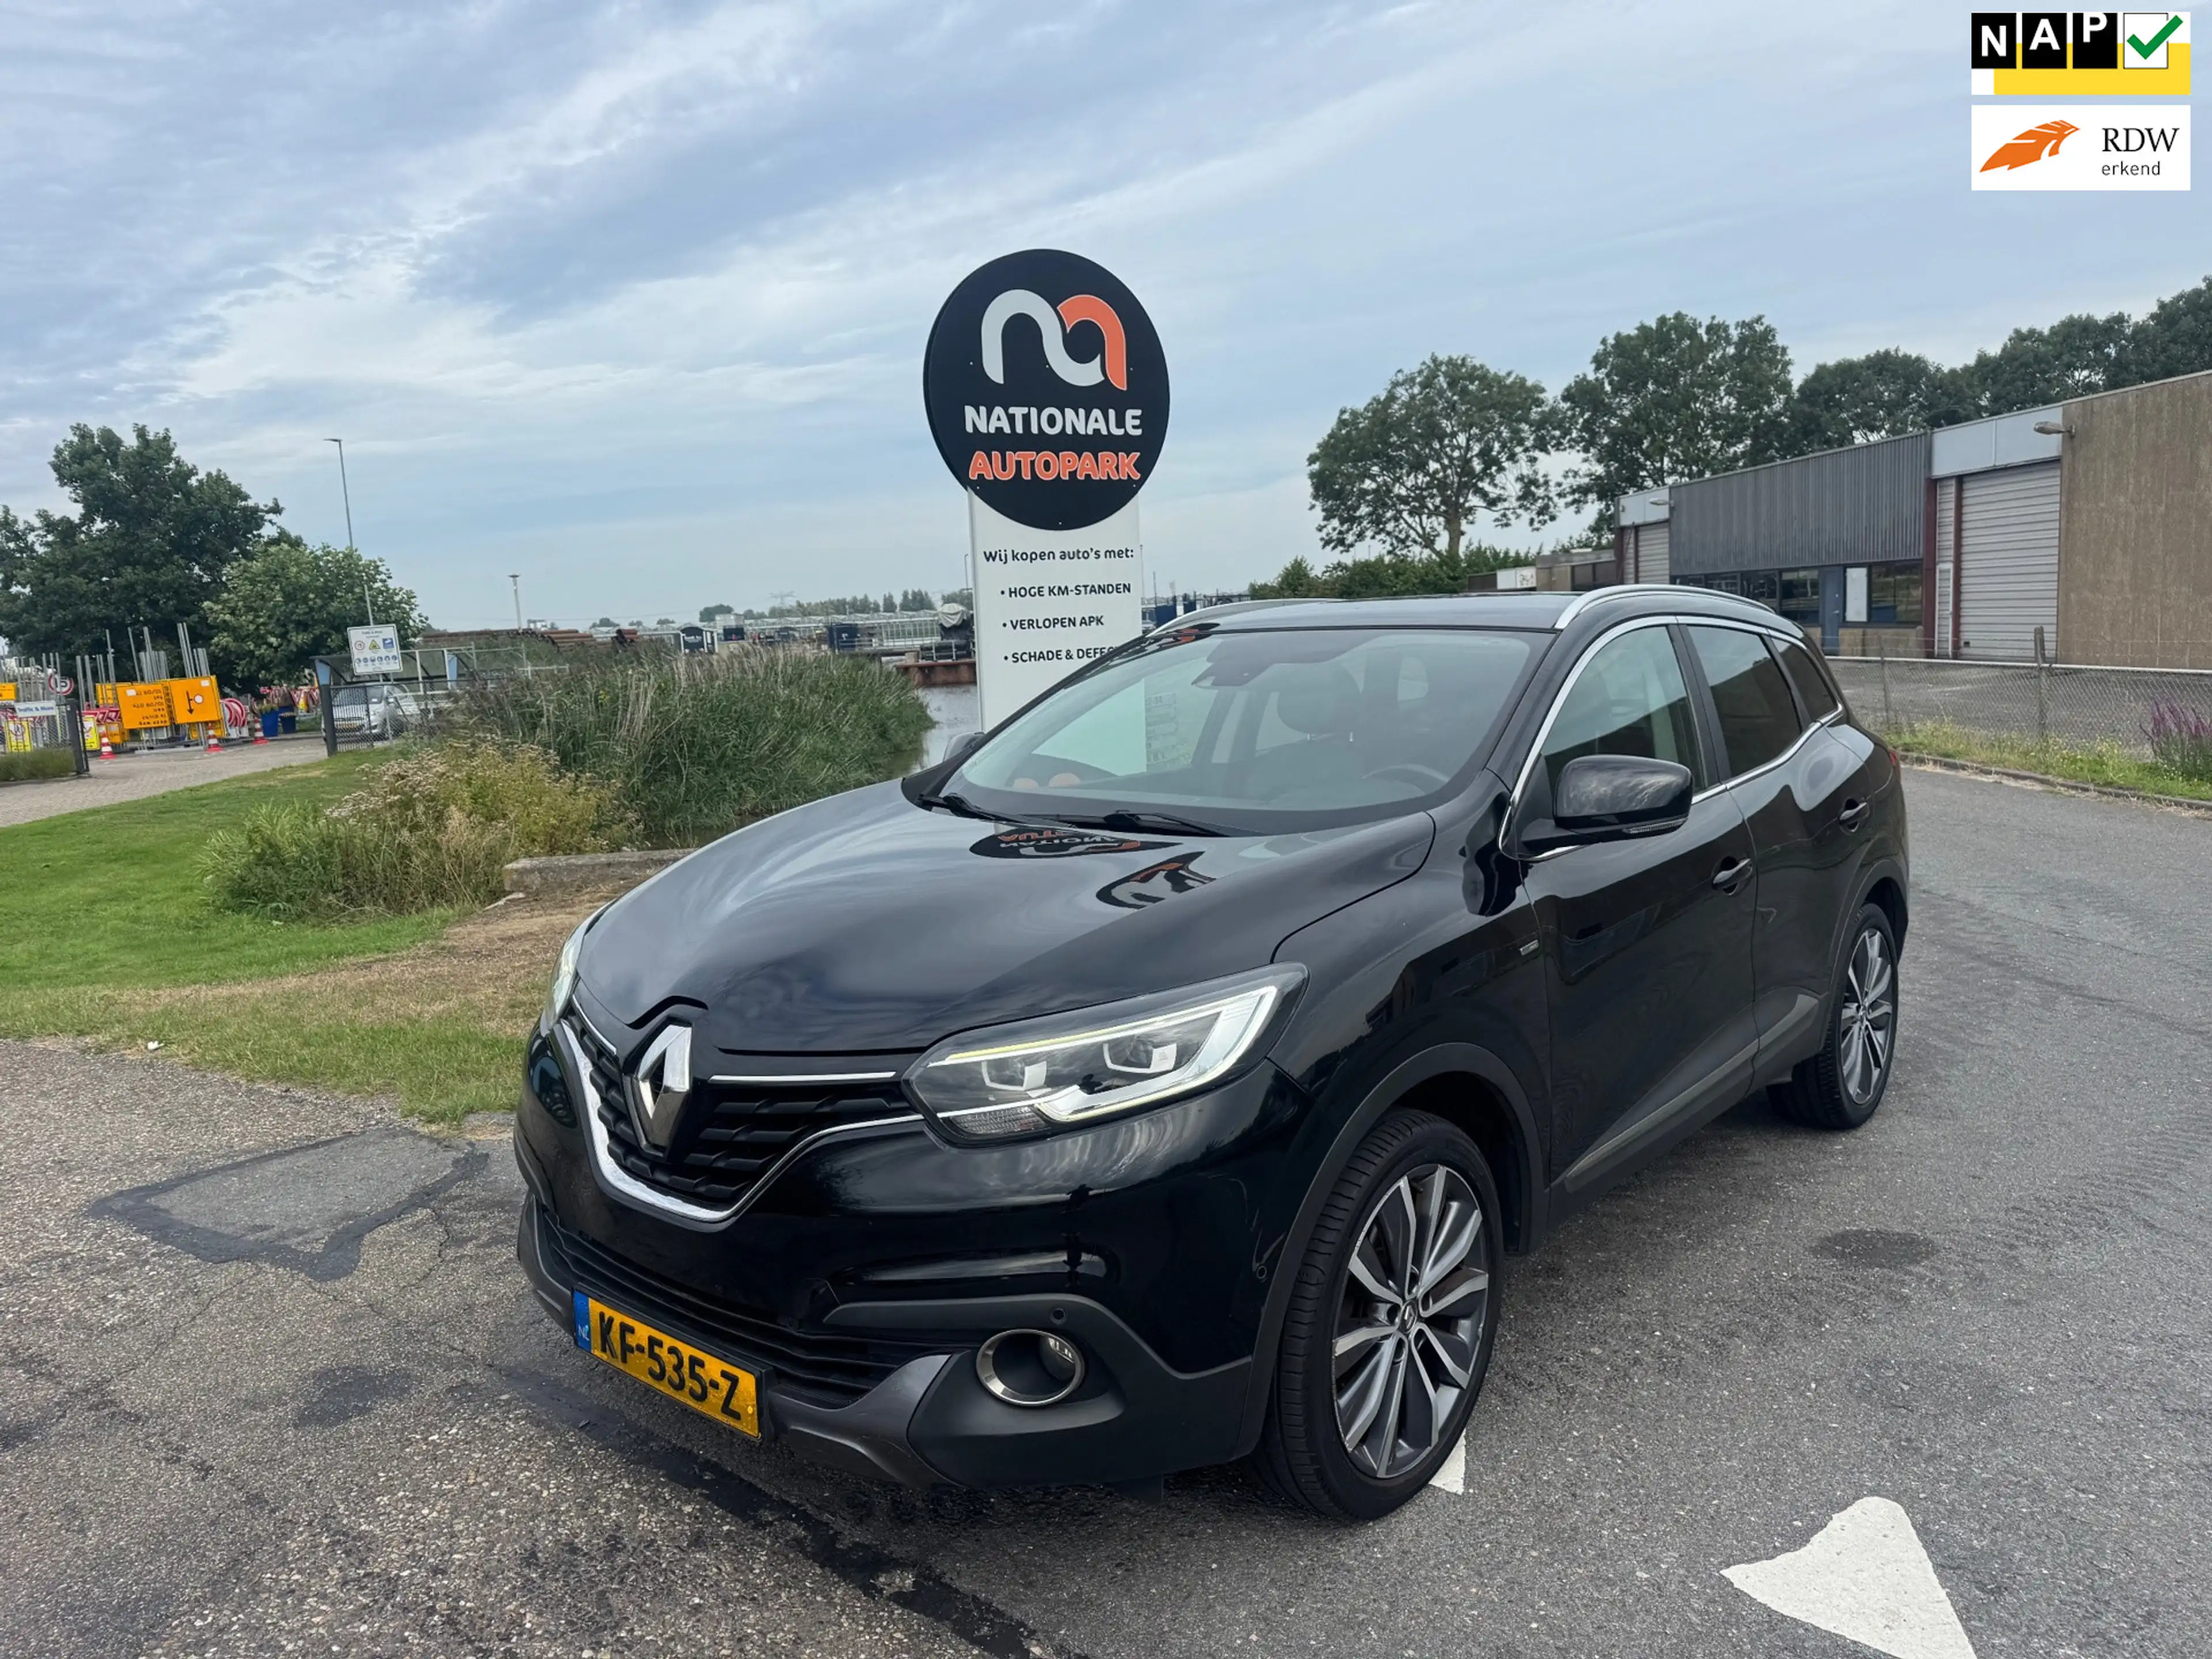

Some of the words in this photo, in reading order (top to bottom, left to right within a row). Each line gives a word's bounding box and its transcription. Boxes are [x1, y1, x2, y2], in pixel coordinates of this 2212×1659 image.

[964, 405, 1142, 435] NATIONALE
[968, 450, 1141, 480] AUTOPARK
[983, 549, 1008, 565] Wij
[1011, 549, 1056, 564] kopen
[1104, 547, 1134, 559] met:
[1009, 586, 1045, 598] HOGE
[1048, 582, 1131, 597] KM-STANDEN
[1010, 616, 1077, 630] VERLOPEN
[1079, 615, 1104, 627] APK
[1012, 649, 1063, 664] SCHADE
[1065, 649, 1074, 660] &
[578, 1324, 590, 1341] NL
[599, 1311, 741, 1421] KF-535-Z
